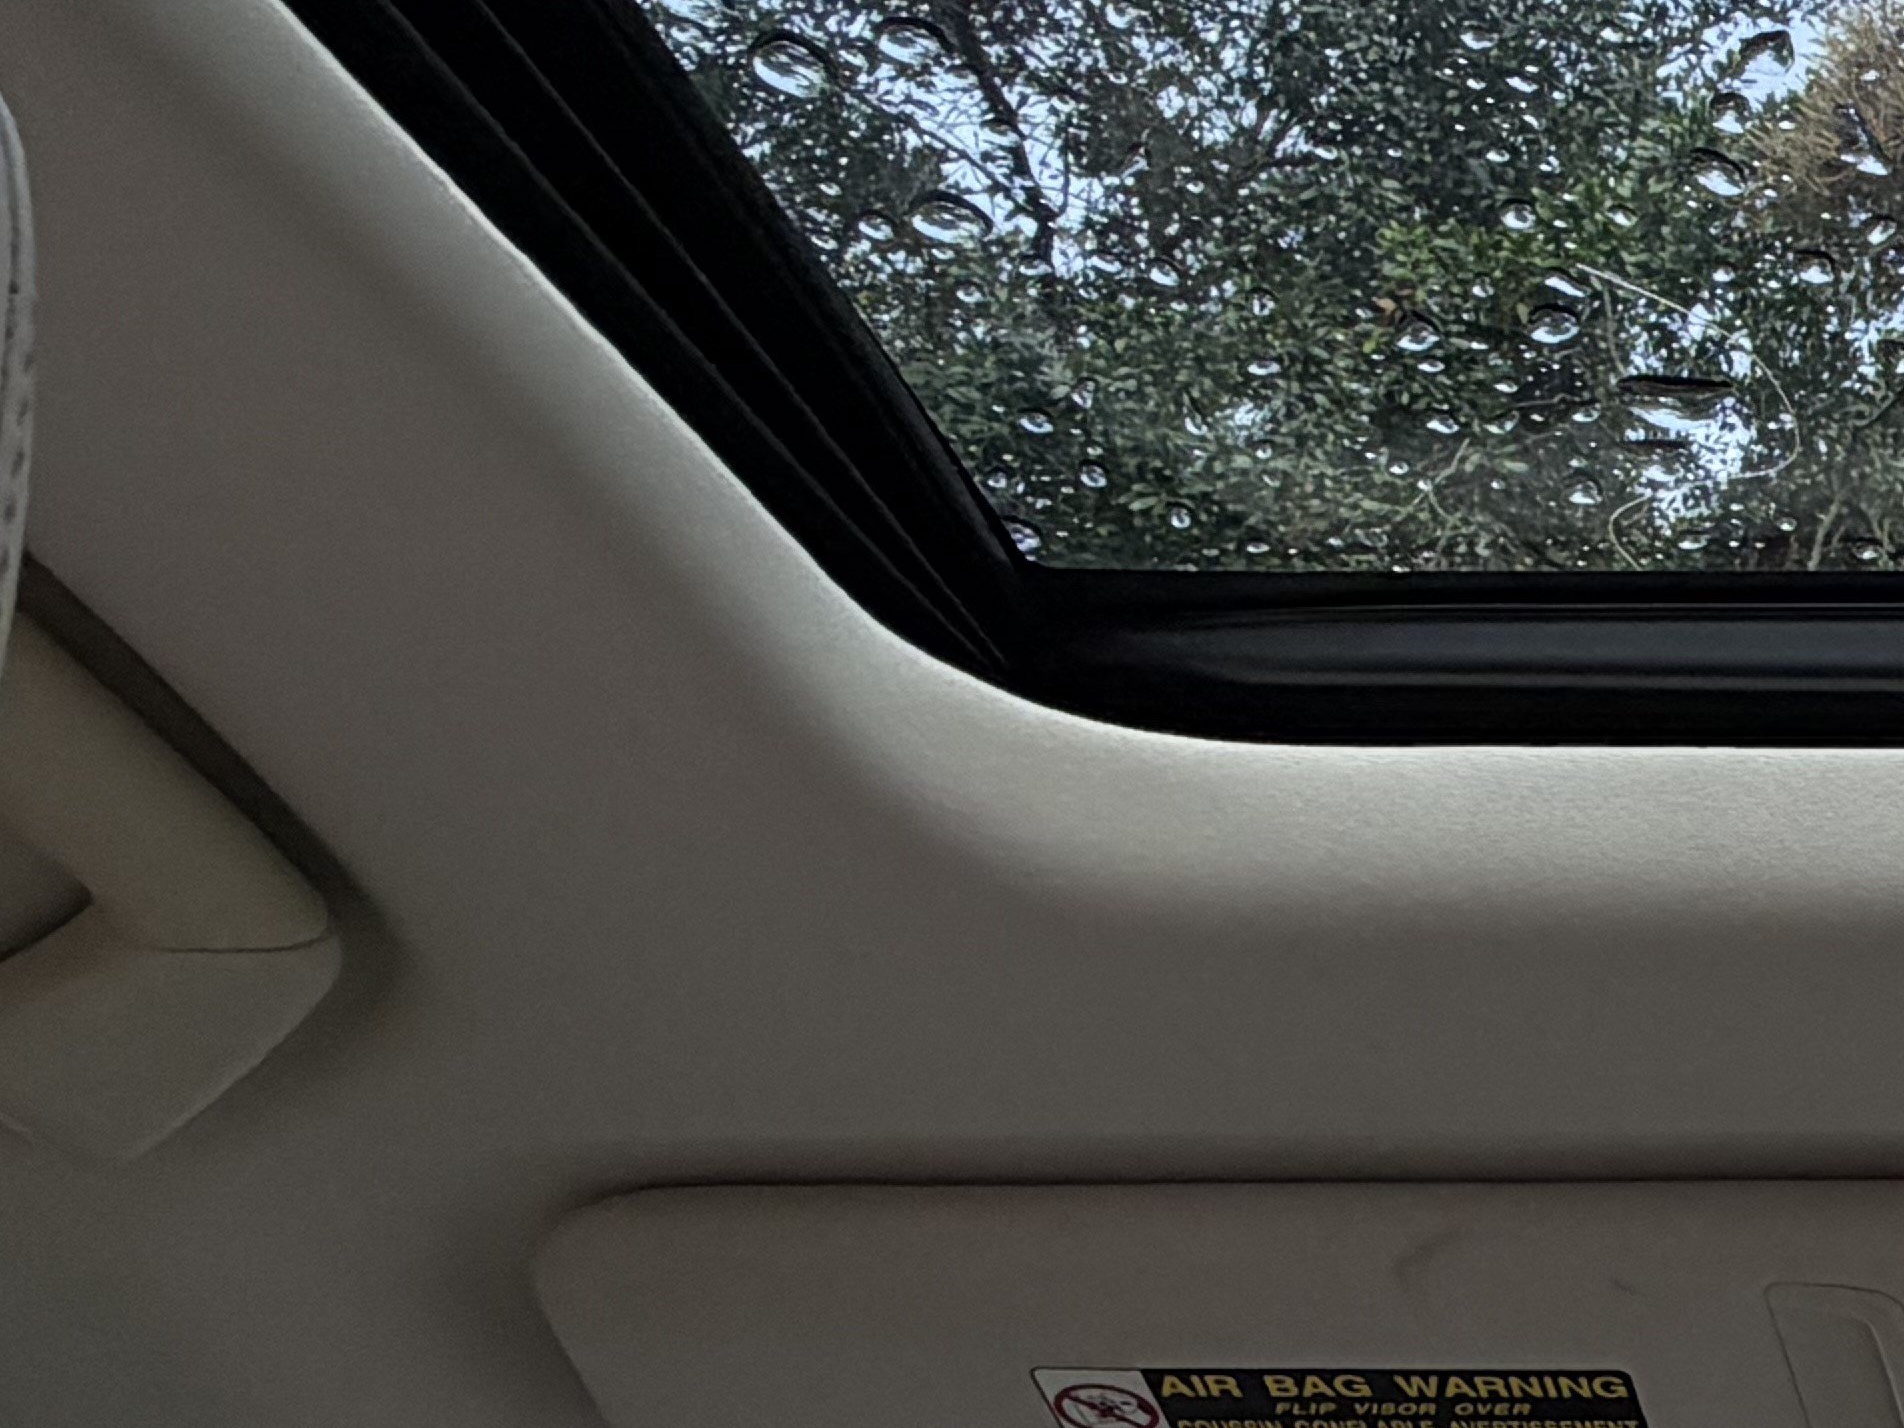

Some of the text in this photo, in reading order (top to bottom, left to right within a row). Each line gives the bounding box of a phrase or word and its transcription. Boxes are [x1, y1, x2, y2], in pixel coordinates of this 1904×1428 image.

[1160, 1374, 1631, 1399] AIR BAG WARNING
[1273, 1401, 1533, 1417] FLIP VISOR OVER
